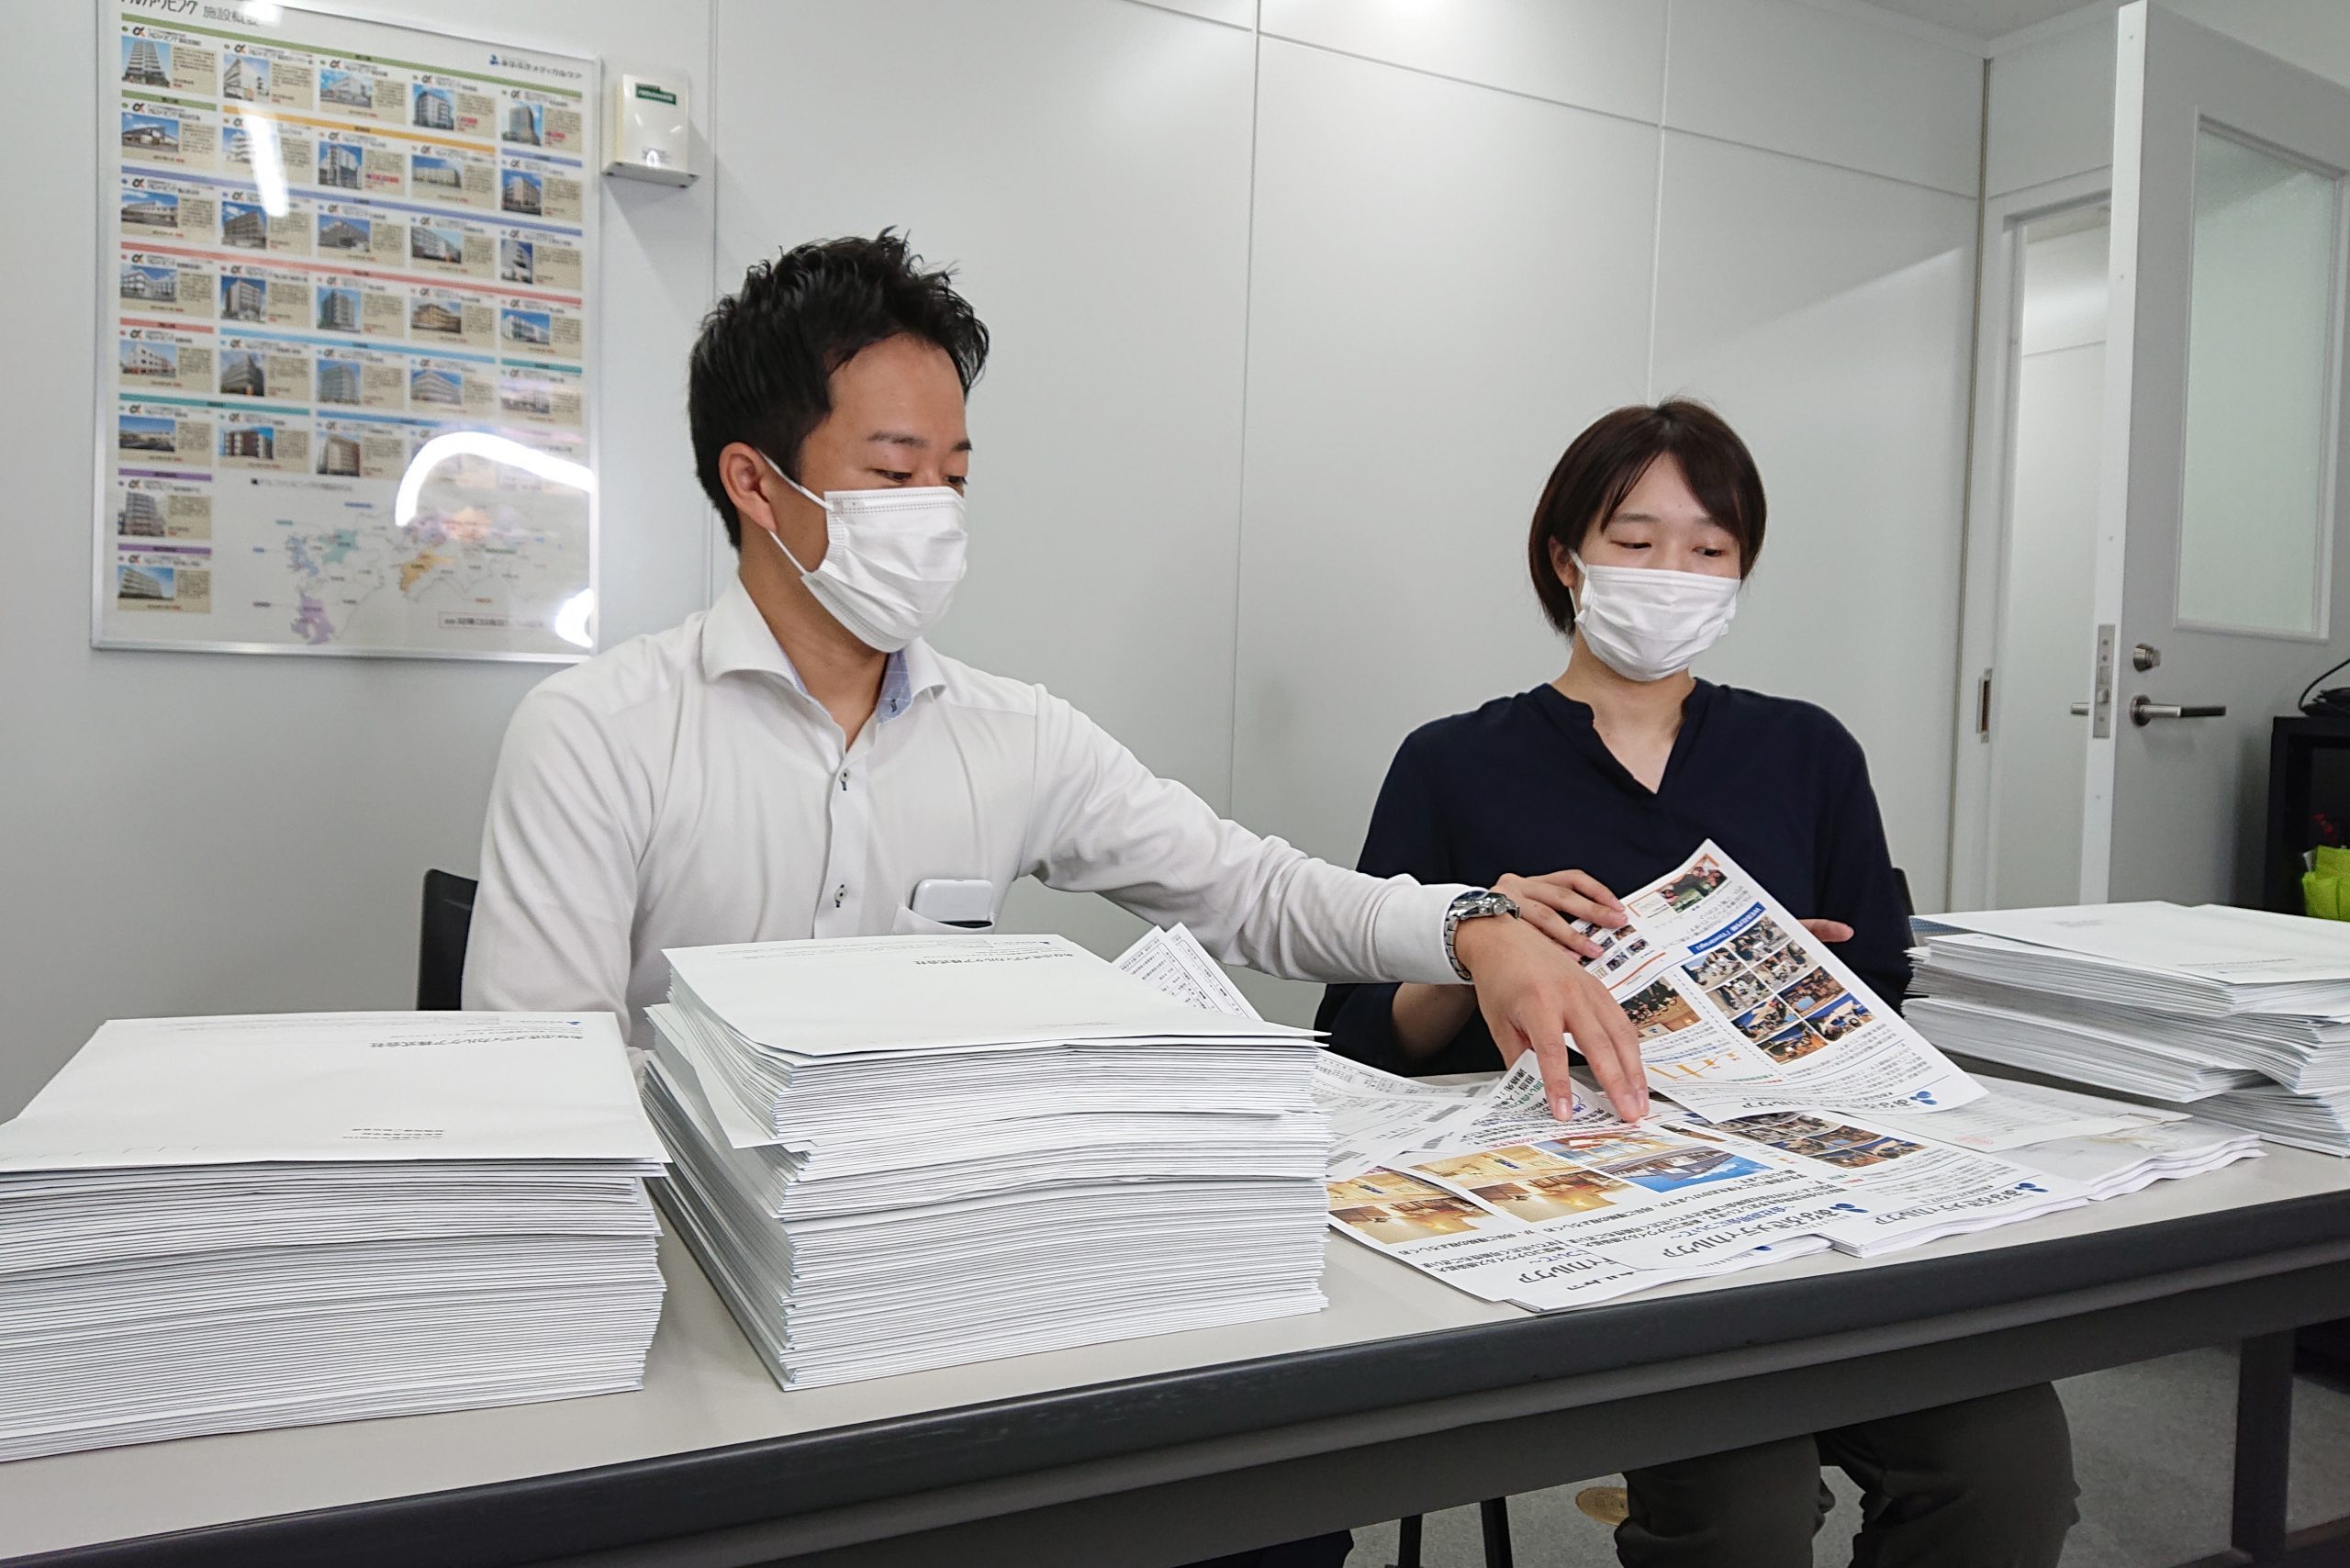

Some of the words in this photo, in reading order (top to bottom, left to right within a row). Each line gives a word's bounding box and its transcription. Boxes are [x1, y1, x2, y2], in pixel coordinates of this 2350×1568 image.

[1662, 1208, 1841, 1259] あなぶきメディカルケア
